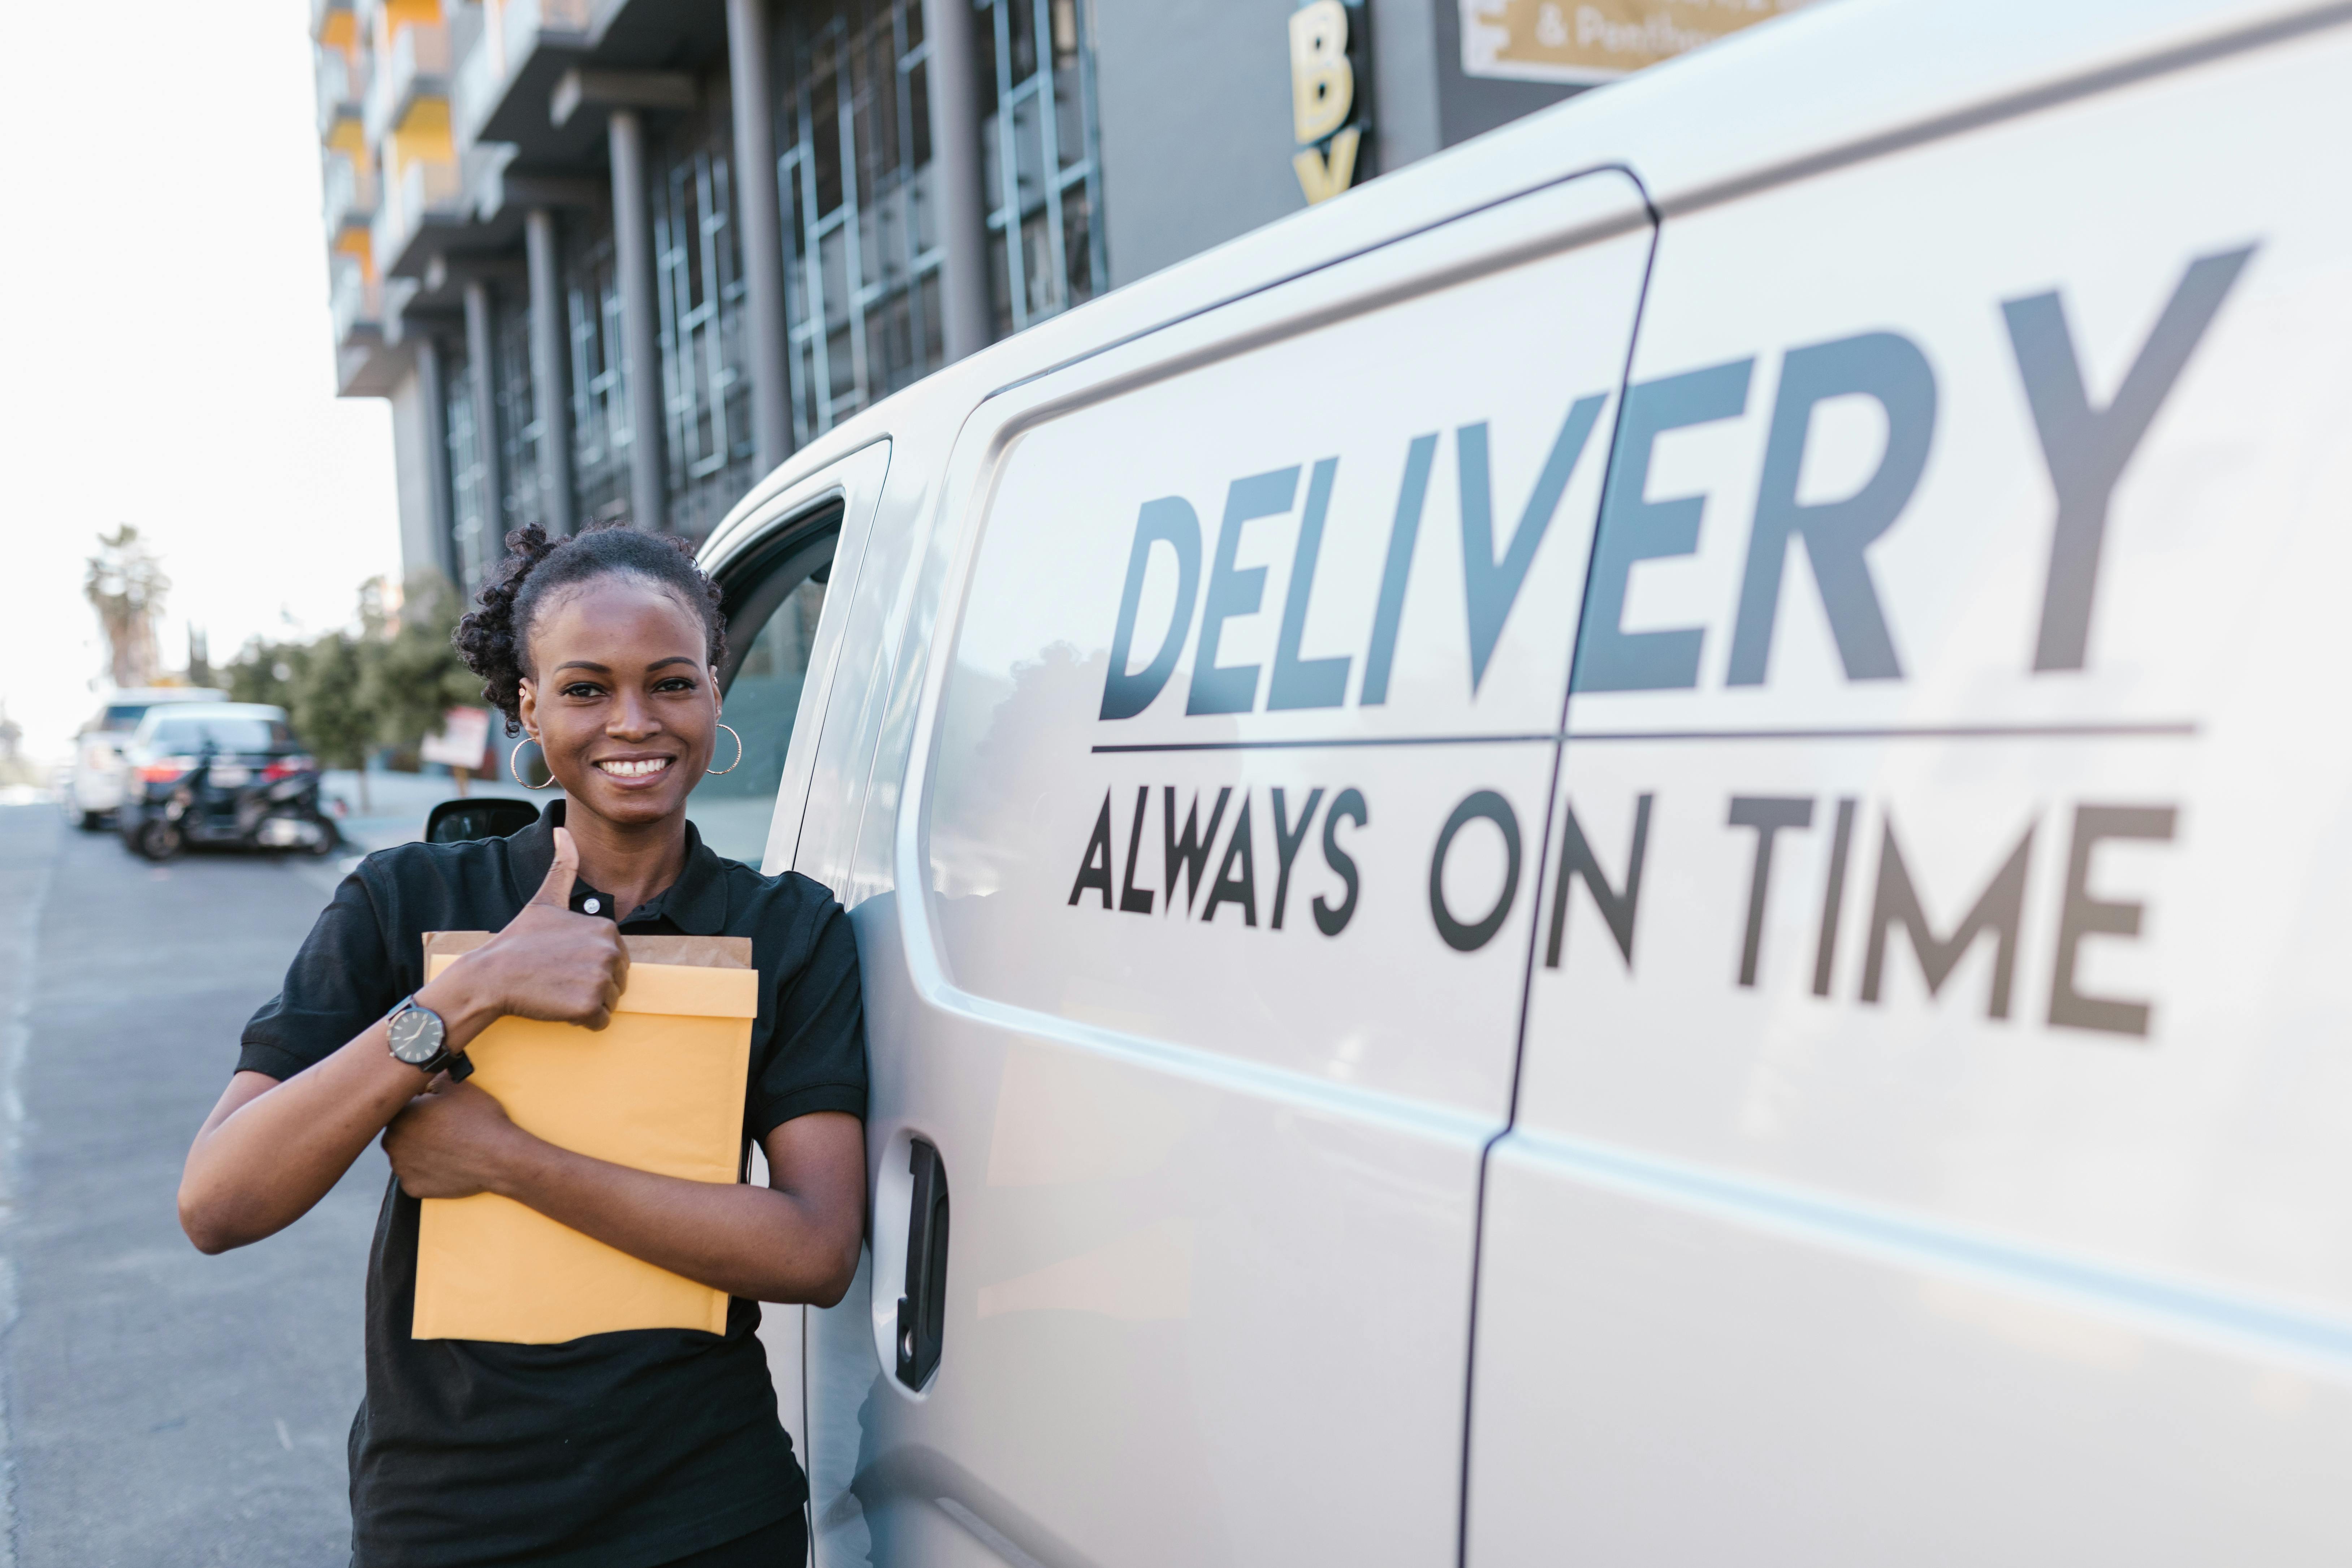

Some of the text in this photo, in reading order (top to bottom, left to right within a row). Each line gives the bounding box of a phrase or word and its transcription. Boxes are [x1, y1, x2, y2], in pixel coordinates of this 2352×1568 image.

[1536, 3, 1568, 47] &
[1097, 241, 2262, 721] DELIVERY
[1065, 784, 2182, 1042] ALWAYS ON TIME
